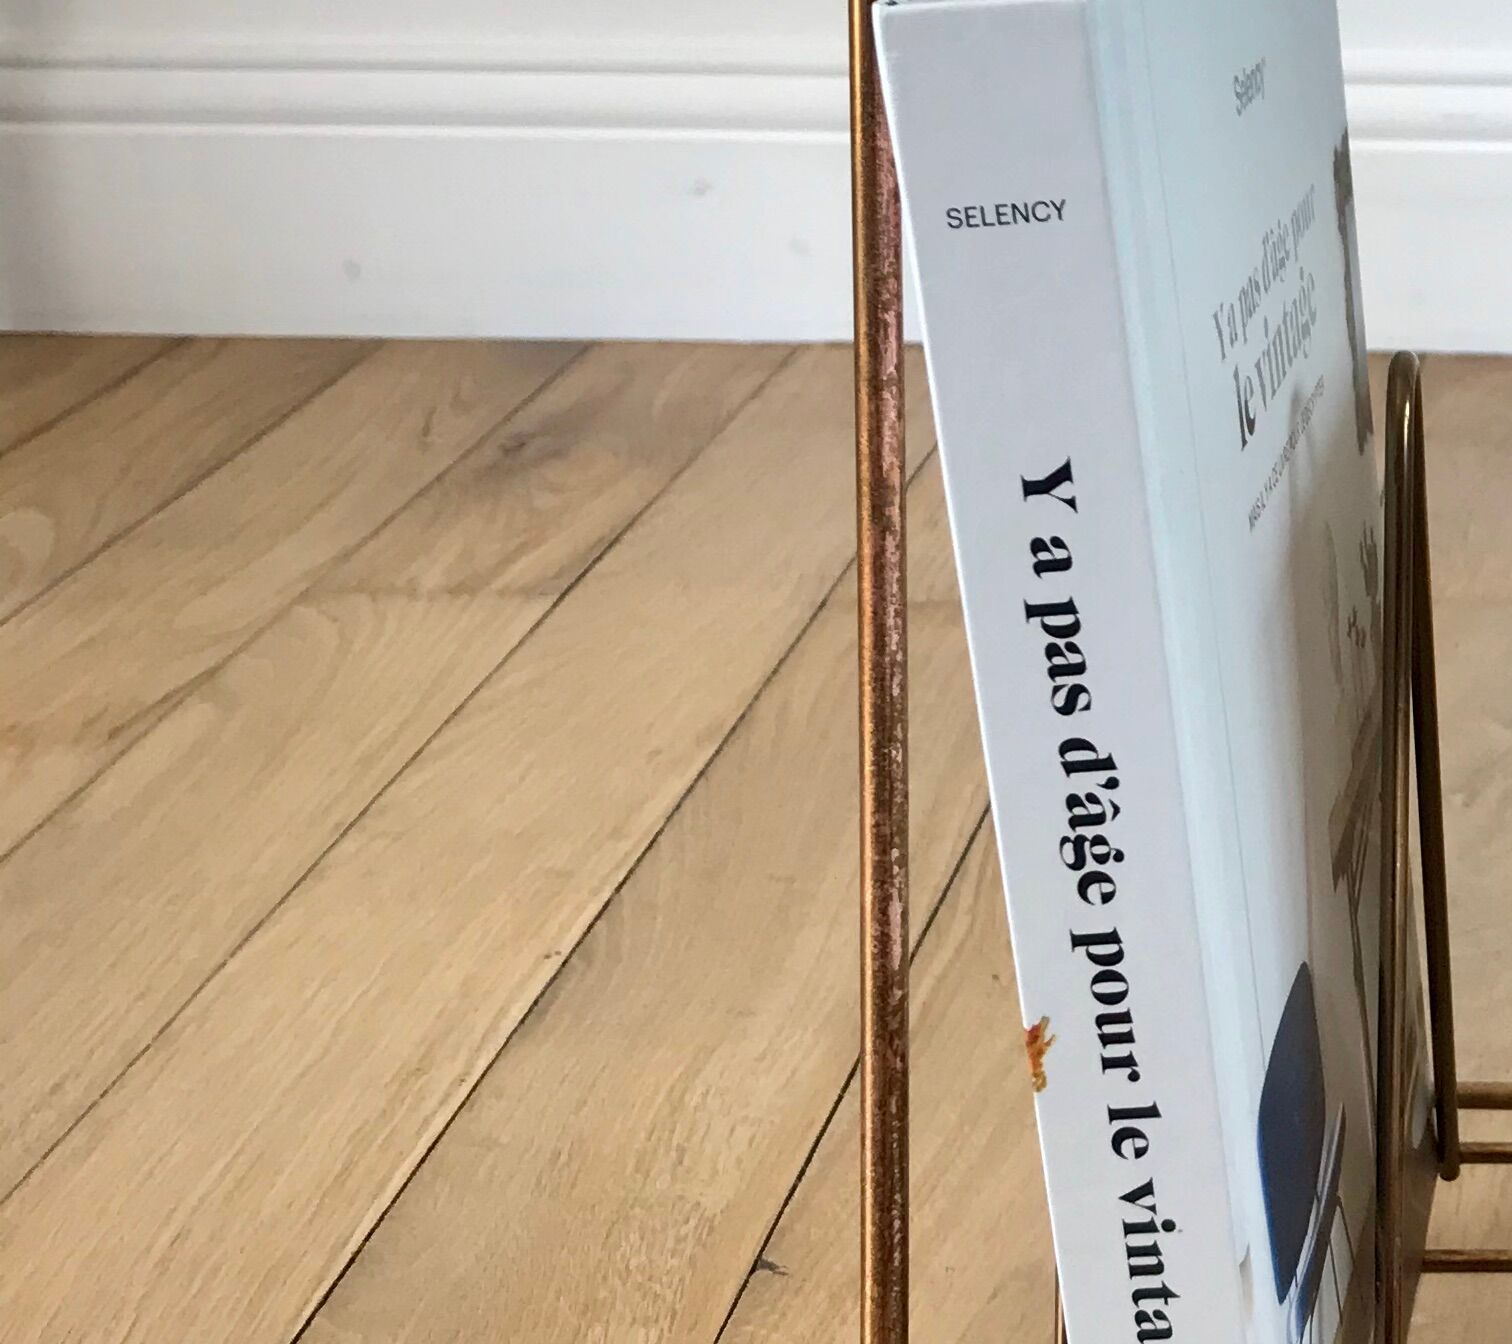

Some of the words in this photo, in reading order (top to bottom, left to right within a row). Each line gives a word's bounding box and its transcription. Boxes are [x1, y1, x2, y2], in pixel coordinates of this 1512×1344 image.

[945, 199, 1067, 230] SELENCY
[1238, 266, 1261, 345] pas
[1233, 363, 1257, 452] le
[1254, 266, 1317, 412] vintage
[1020, 456, 1079, 514] Y
[1029, 534, 1074, 578] a
[1023, 596, 1092, 718] pas
[1057, 736, 1126, 906] d'âge
[1069, 927, 1141, 1083] pour
[1107, 1100, 1163, 1161] le
